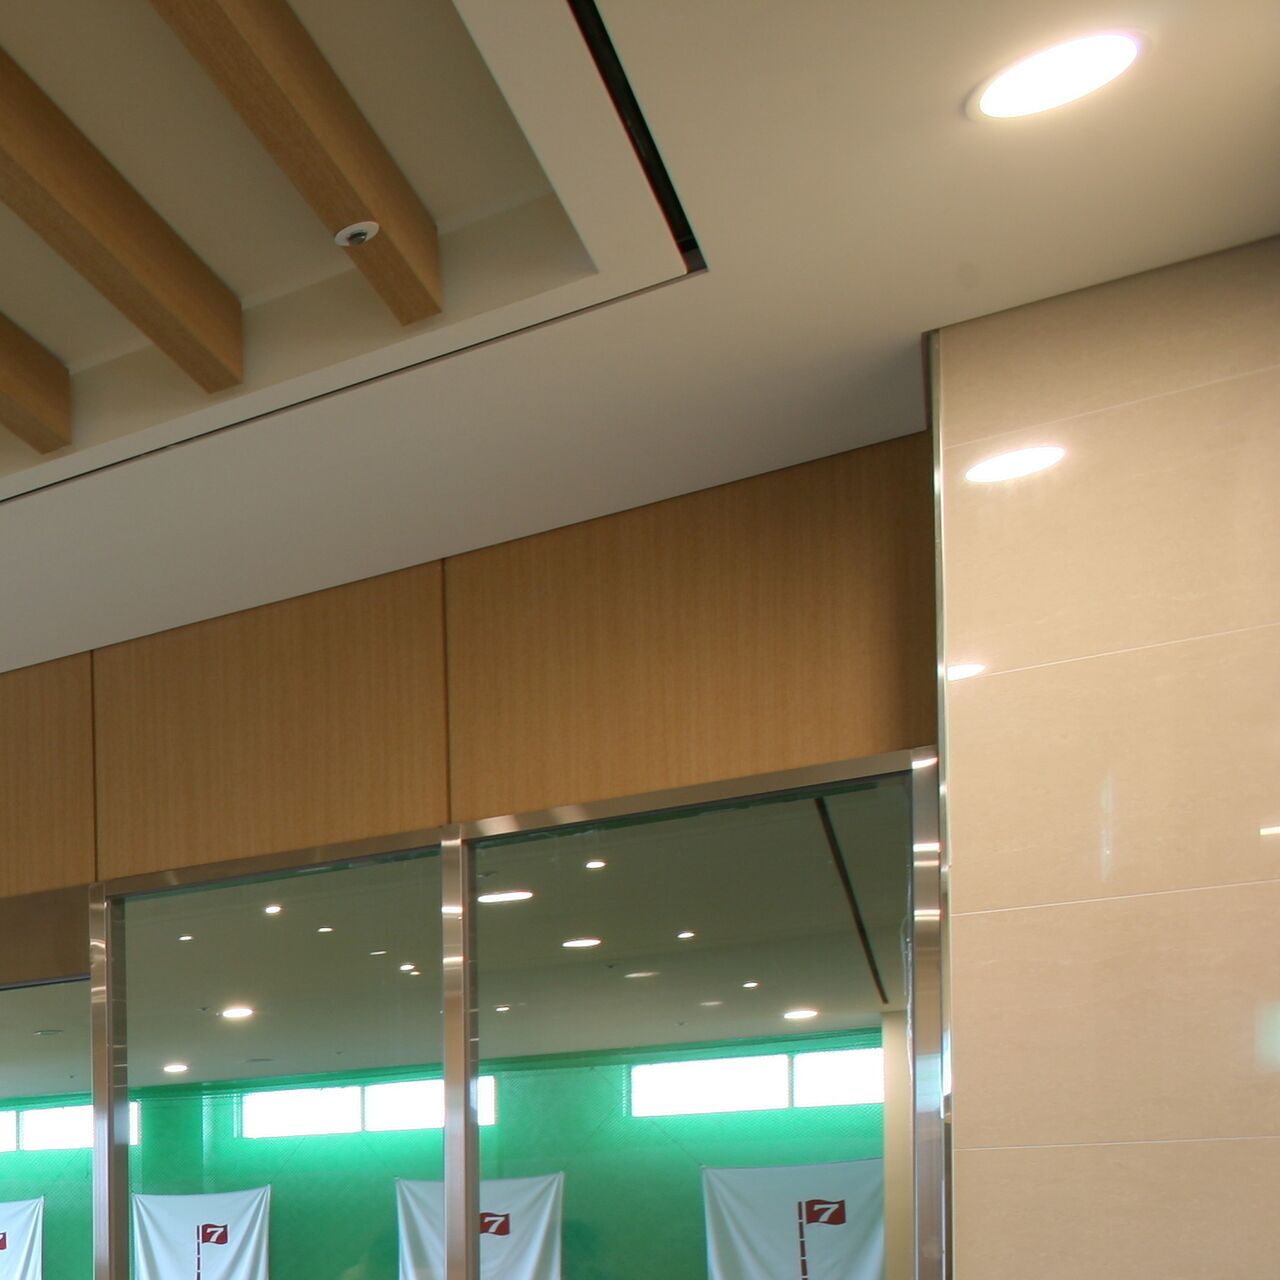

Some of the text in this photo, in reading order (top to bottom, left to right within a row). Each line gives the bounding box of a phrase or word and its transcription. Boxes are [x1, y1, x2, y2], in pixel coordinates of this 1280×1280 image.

[813, 1203, 840, 1222] 7
[484, 1216, 506, 1233] 7
[206, 1227, 225, 1242] 7
